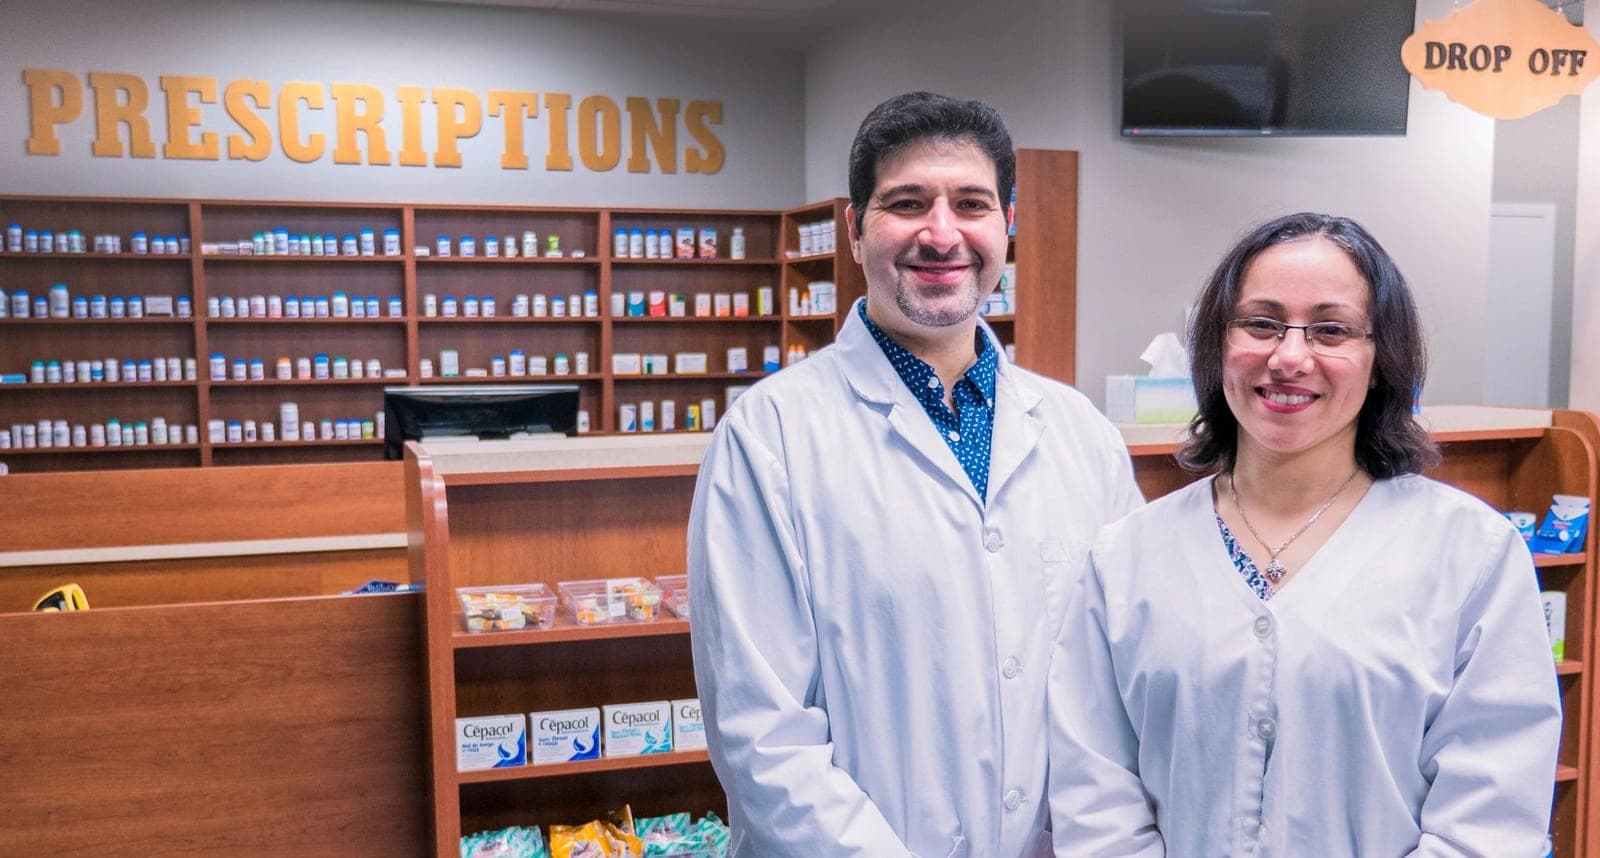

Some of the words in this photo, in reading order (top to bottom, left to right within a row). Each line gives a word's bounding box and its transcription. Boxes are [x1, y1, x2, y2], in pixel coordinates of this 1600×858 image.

[1424, 41, 1512, 73] DROP
[1528, 48, 1587, 77] OFF
[25, 68, 725, 175] PRESCRIPTIONS
